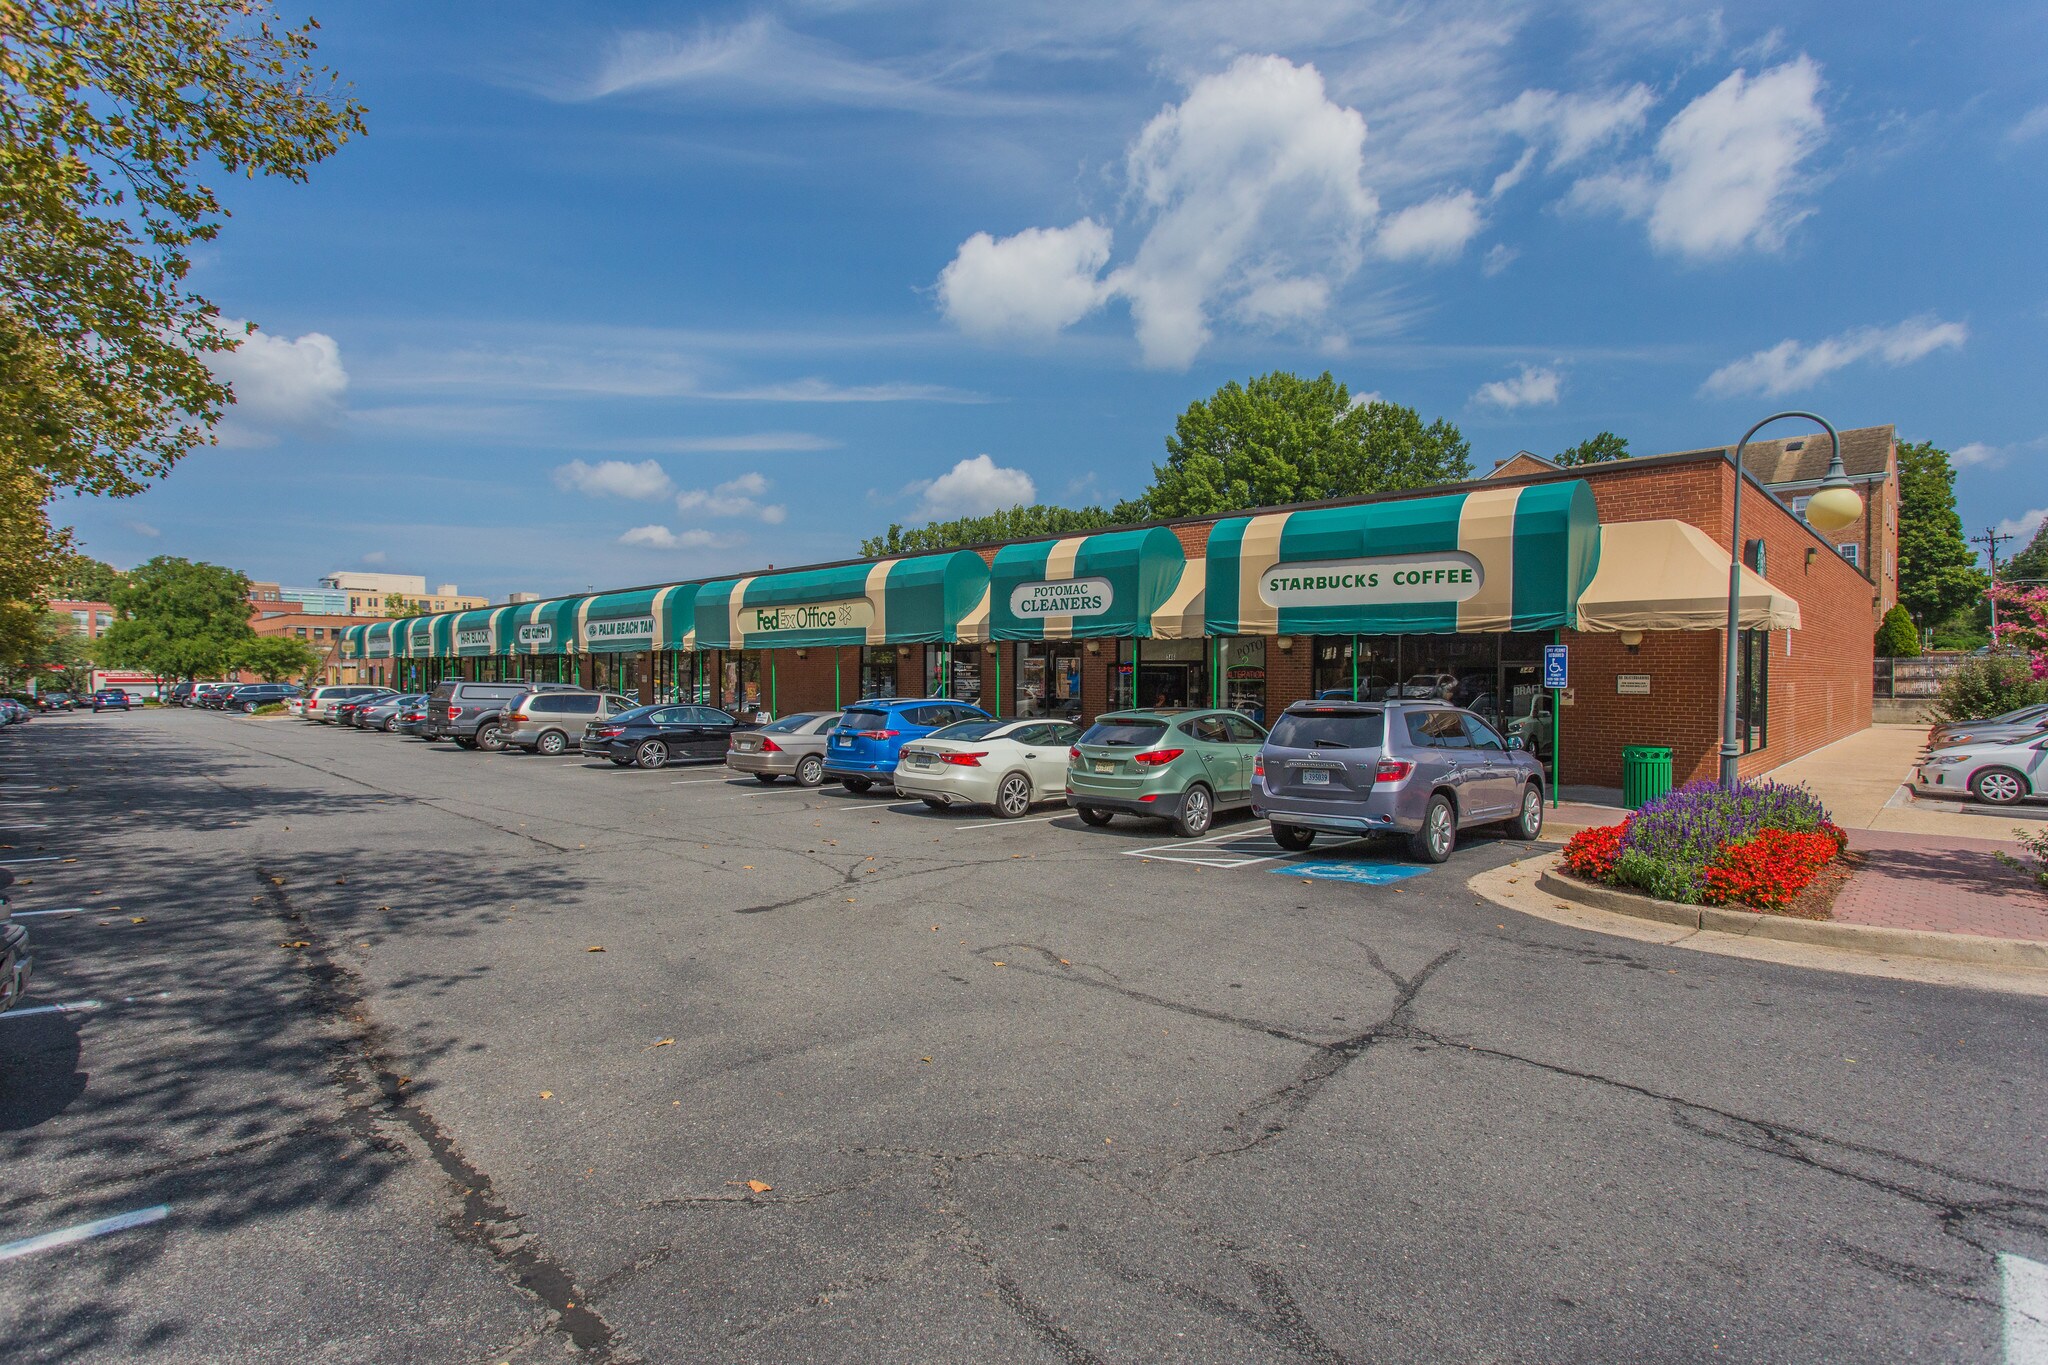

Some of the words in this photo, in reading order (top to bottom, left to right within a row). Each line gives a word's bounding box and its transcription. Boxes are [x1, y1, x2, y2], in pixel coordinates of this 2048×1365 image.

[1270, 573, 1379, 592] STARBUCKS
[1393, 568, 1473, 586] COFFEE
[1034, 584, 1088, 598] POTOMAC
[1021, 595, 1102, 613] CLEANERS
[756, 607, 797, 631] FedEx
[797, 606, 836, 629] Office
[598, 622, 616, 636] PALM
[616, 621, 639, 635] BEACH
[640, 619, 654, 634] TAN
[471, 630, 489, 644] BLOCK
[1513, 684, 1542, 697] DRAFT
